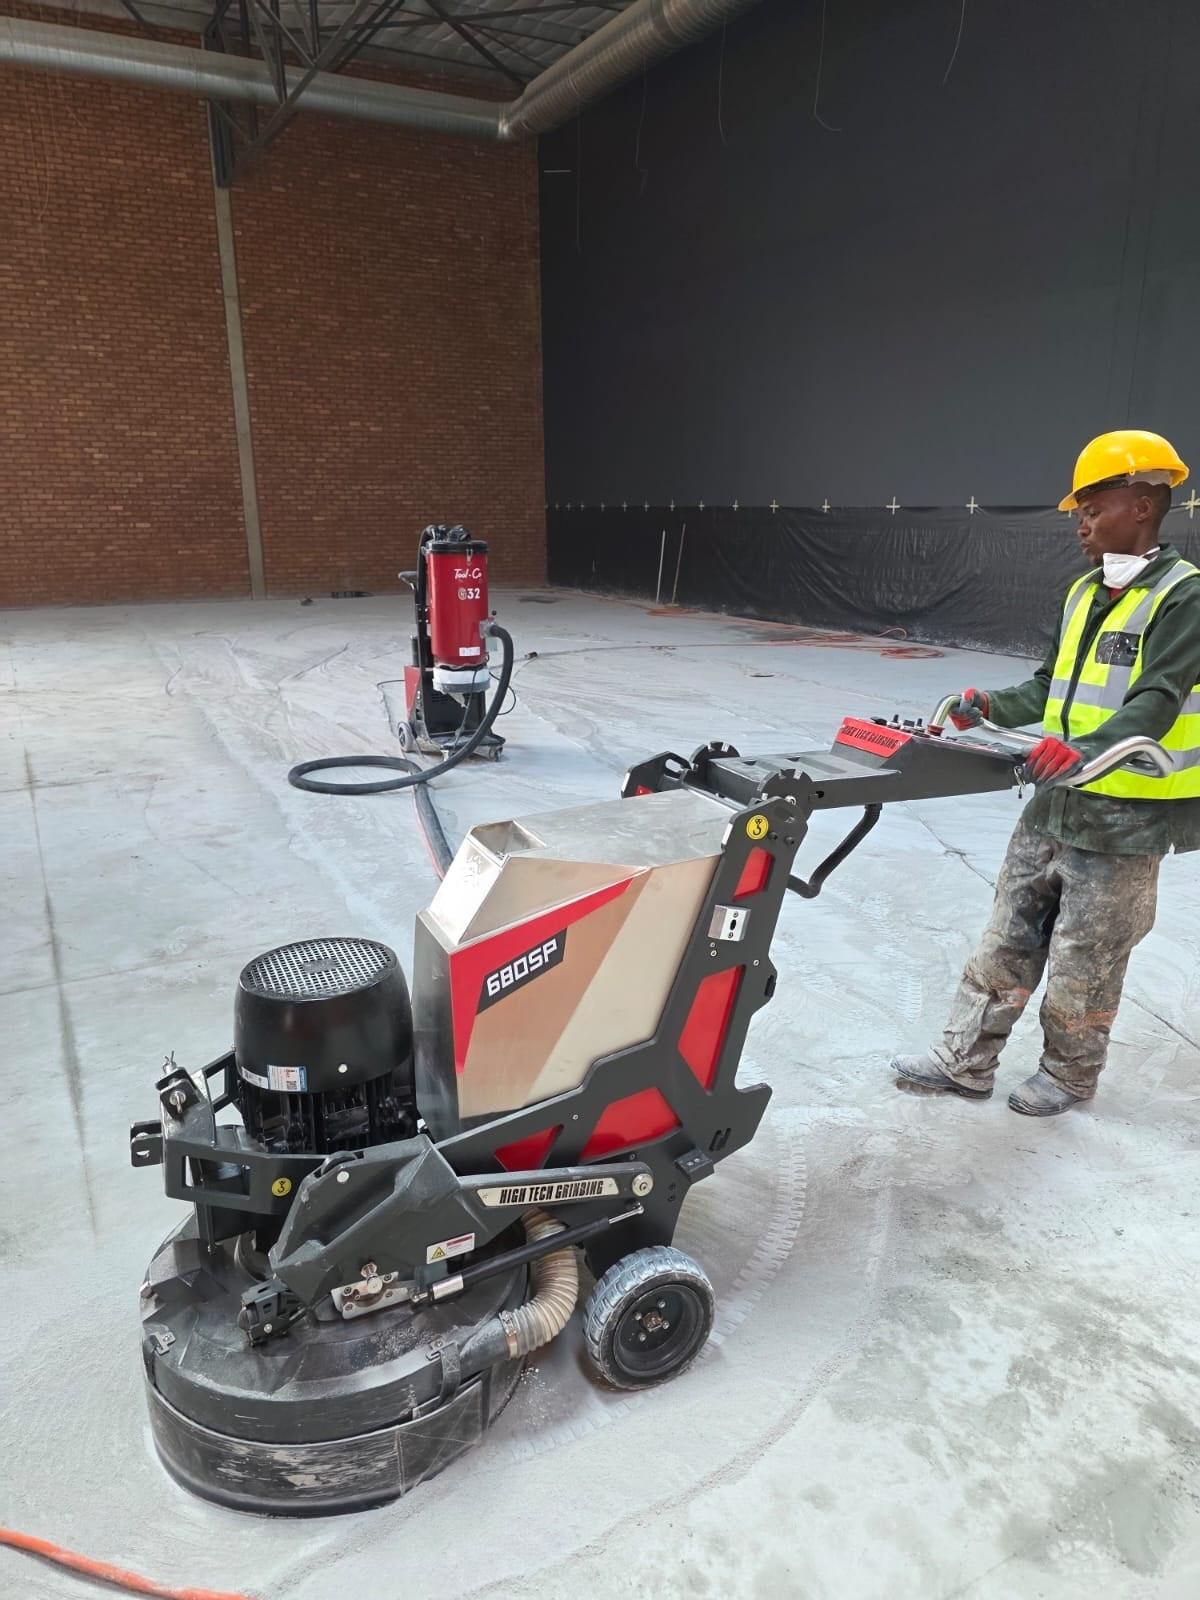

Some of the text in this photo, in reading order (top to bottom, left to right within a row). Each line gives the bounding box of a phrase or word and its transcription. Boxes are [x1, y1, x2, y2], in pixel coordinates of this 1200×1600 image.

[486, 938, 558, 997] 680SP
[499, 1180, 604, 1204] HIGH TECH GRINDING
